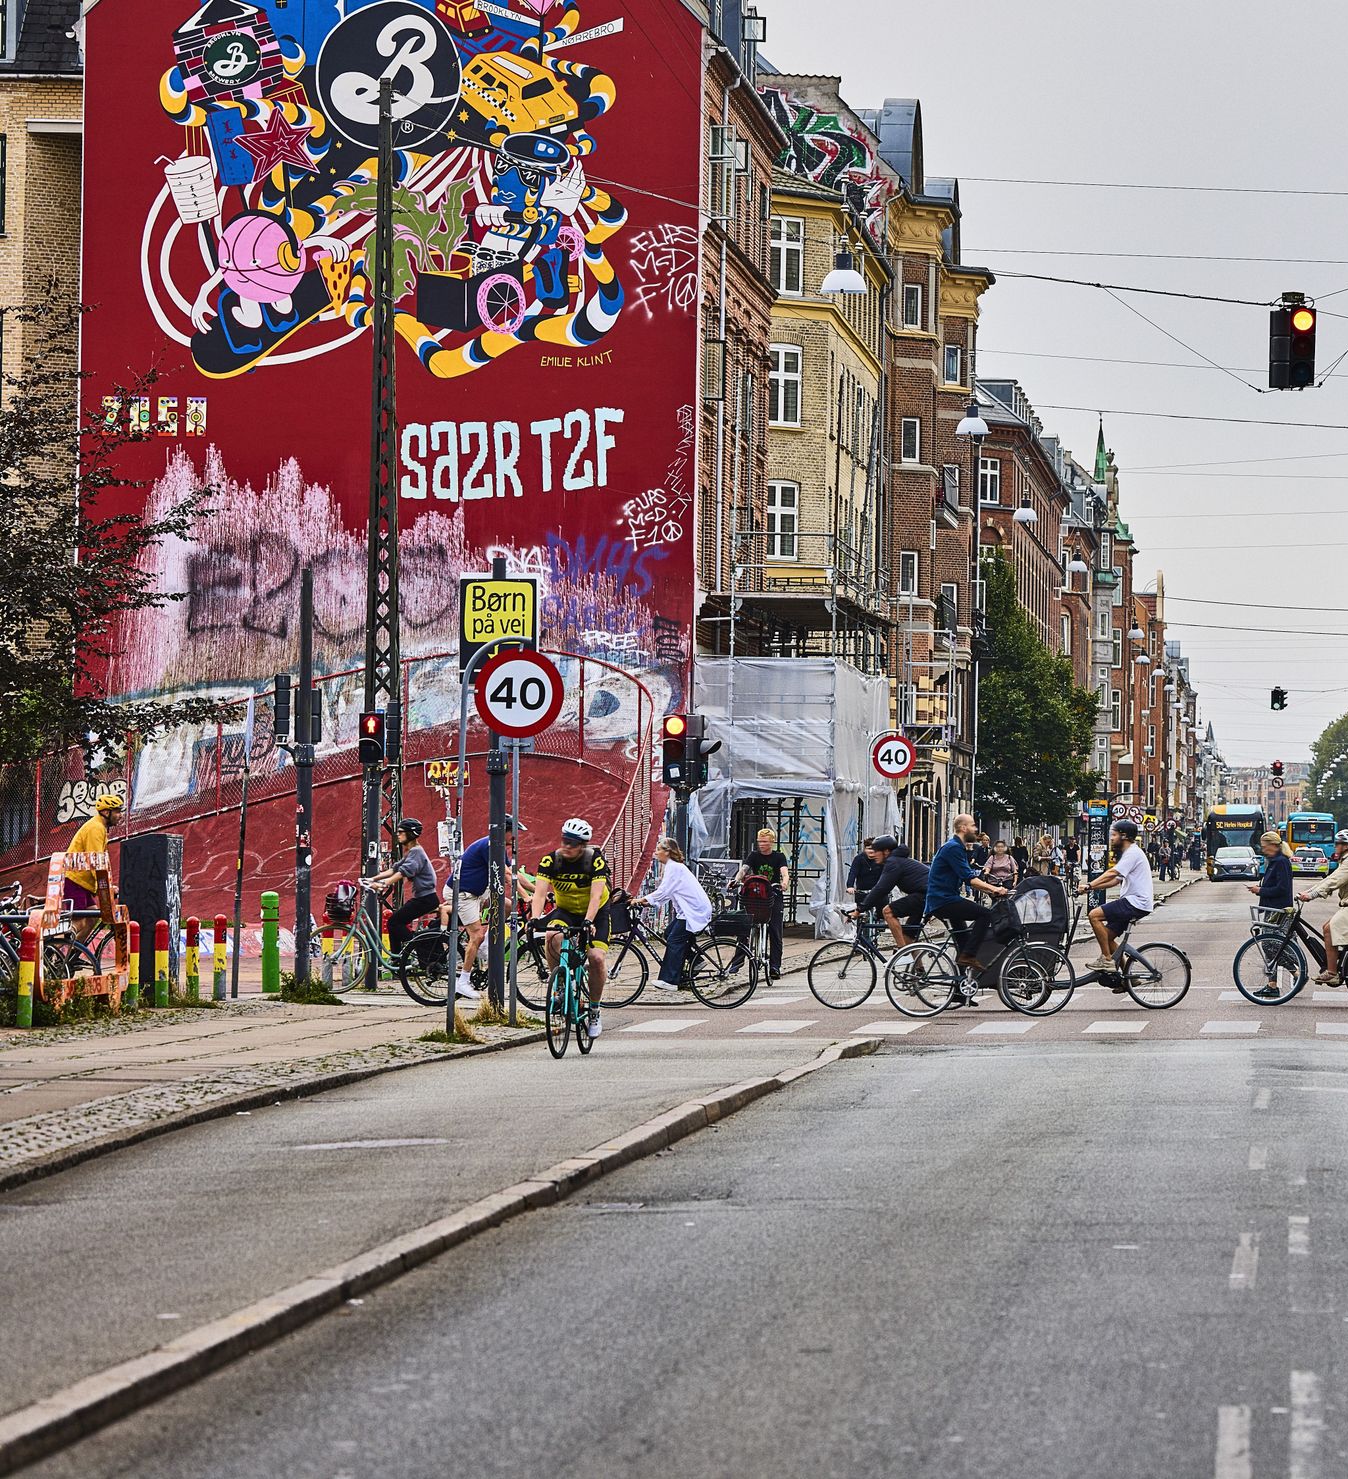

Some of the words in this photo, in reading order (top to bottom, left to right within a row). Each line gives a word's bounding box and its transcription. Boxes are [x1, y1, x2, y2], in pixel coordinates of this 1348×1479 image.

[476, 0, 522, 21] BROOKLYN
[562, 23, 615, 46] NØRREBRO
[208, 70, 241, 84] BREWERY
[577, 350, 613, 367] KLINT
[472, 585, 526, 612] Børn
[472, 613, 495, 639] på
[499, 613, 525, 638] vej
[489, 677, 546, 710] 40
[880, 748, 907, 765] 40
